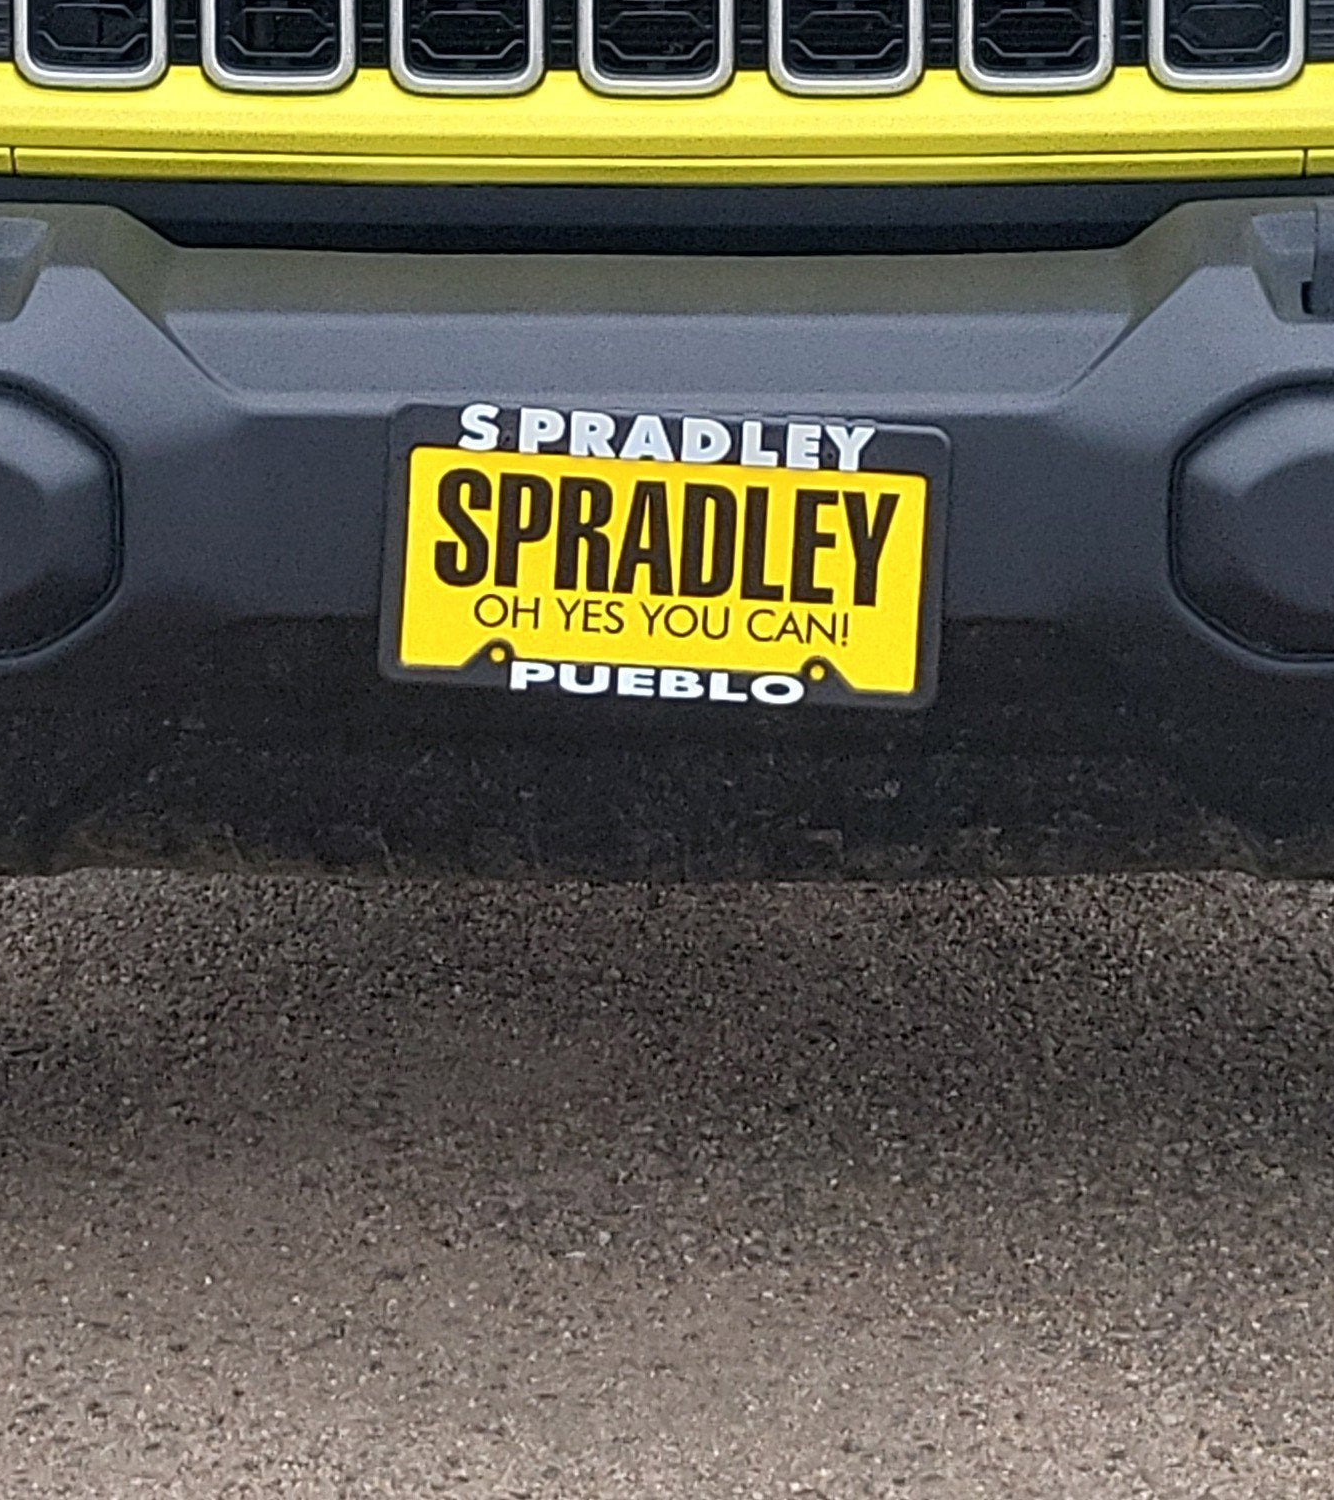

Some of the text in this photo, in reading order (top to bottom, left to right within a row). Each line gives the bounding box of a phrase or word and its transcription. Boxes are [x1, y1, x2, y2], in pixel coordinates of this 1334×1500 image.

[458, 402, 876, 472] SPRADLEY
[433, 467, 901, 608] SPRADLEY
[473, 593, 849, 647] OH YES YOU CAN!
[509, 659, 806, 705] PUEBLO
